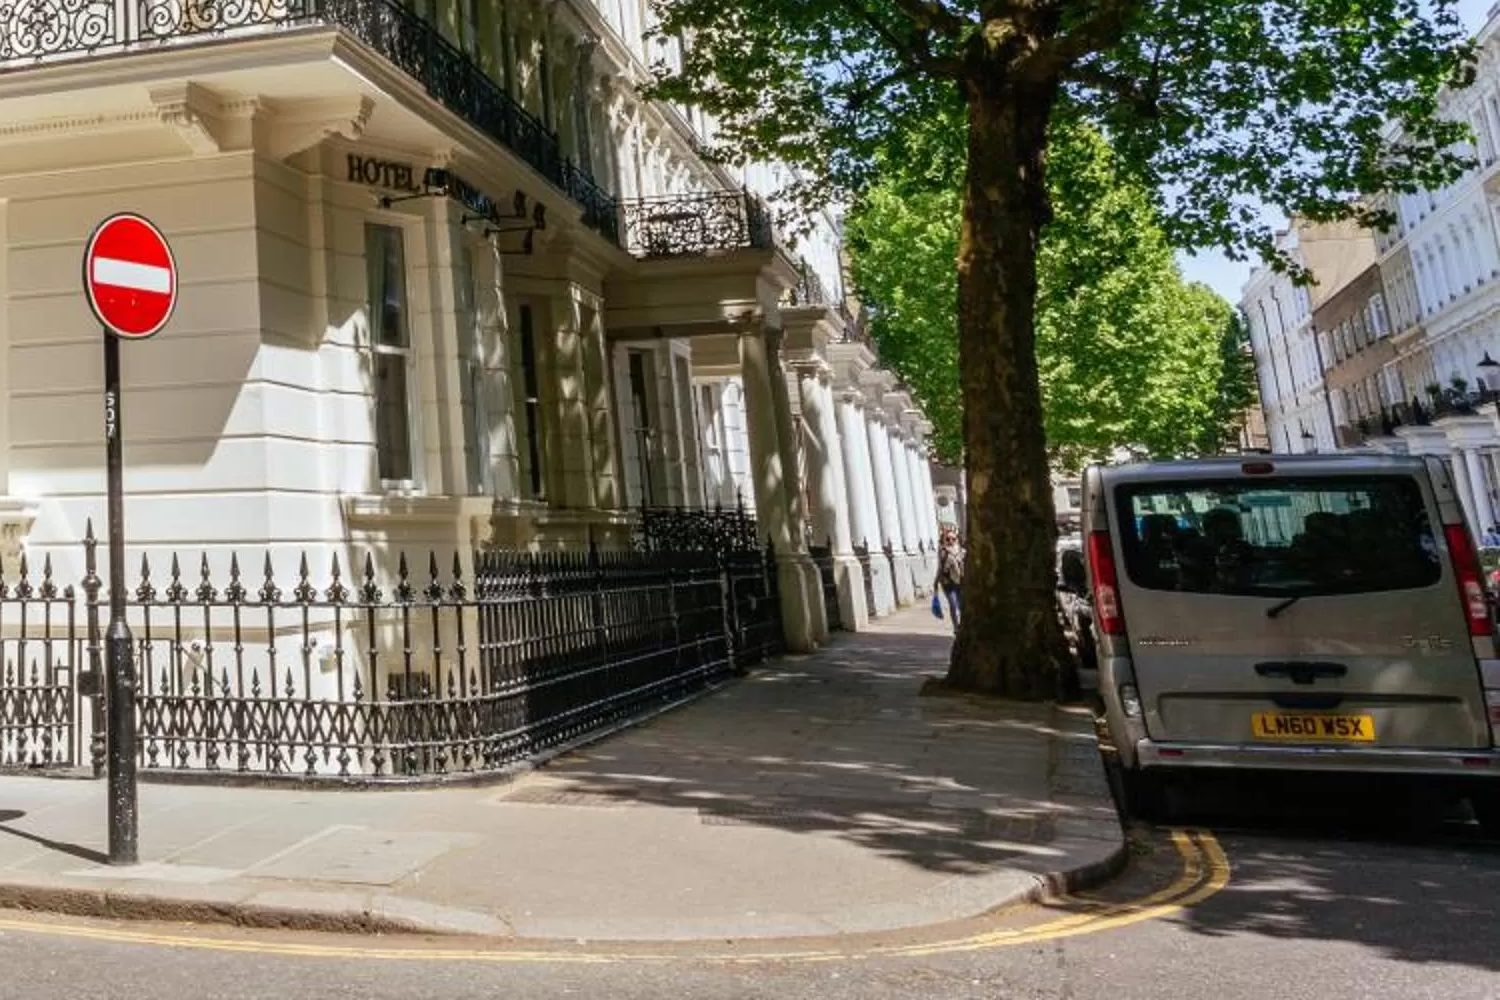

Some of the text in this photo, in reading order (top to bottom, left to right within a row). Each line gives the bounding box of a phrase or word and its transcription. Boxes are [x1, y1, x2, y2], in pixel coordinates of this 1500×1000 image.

[347, 152, 421, 193] HOTEL
[1261, 713, 1364, 737] LN60 WSX
